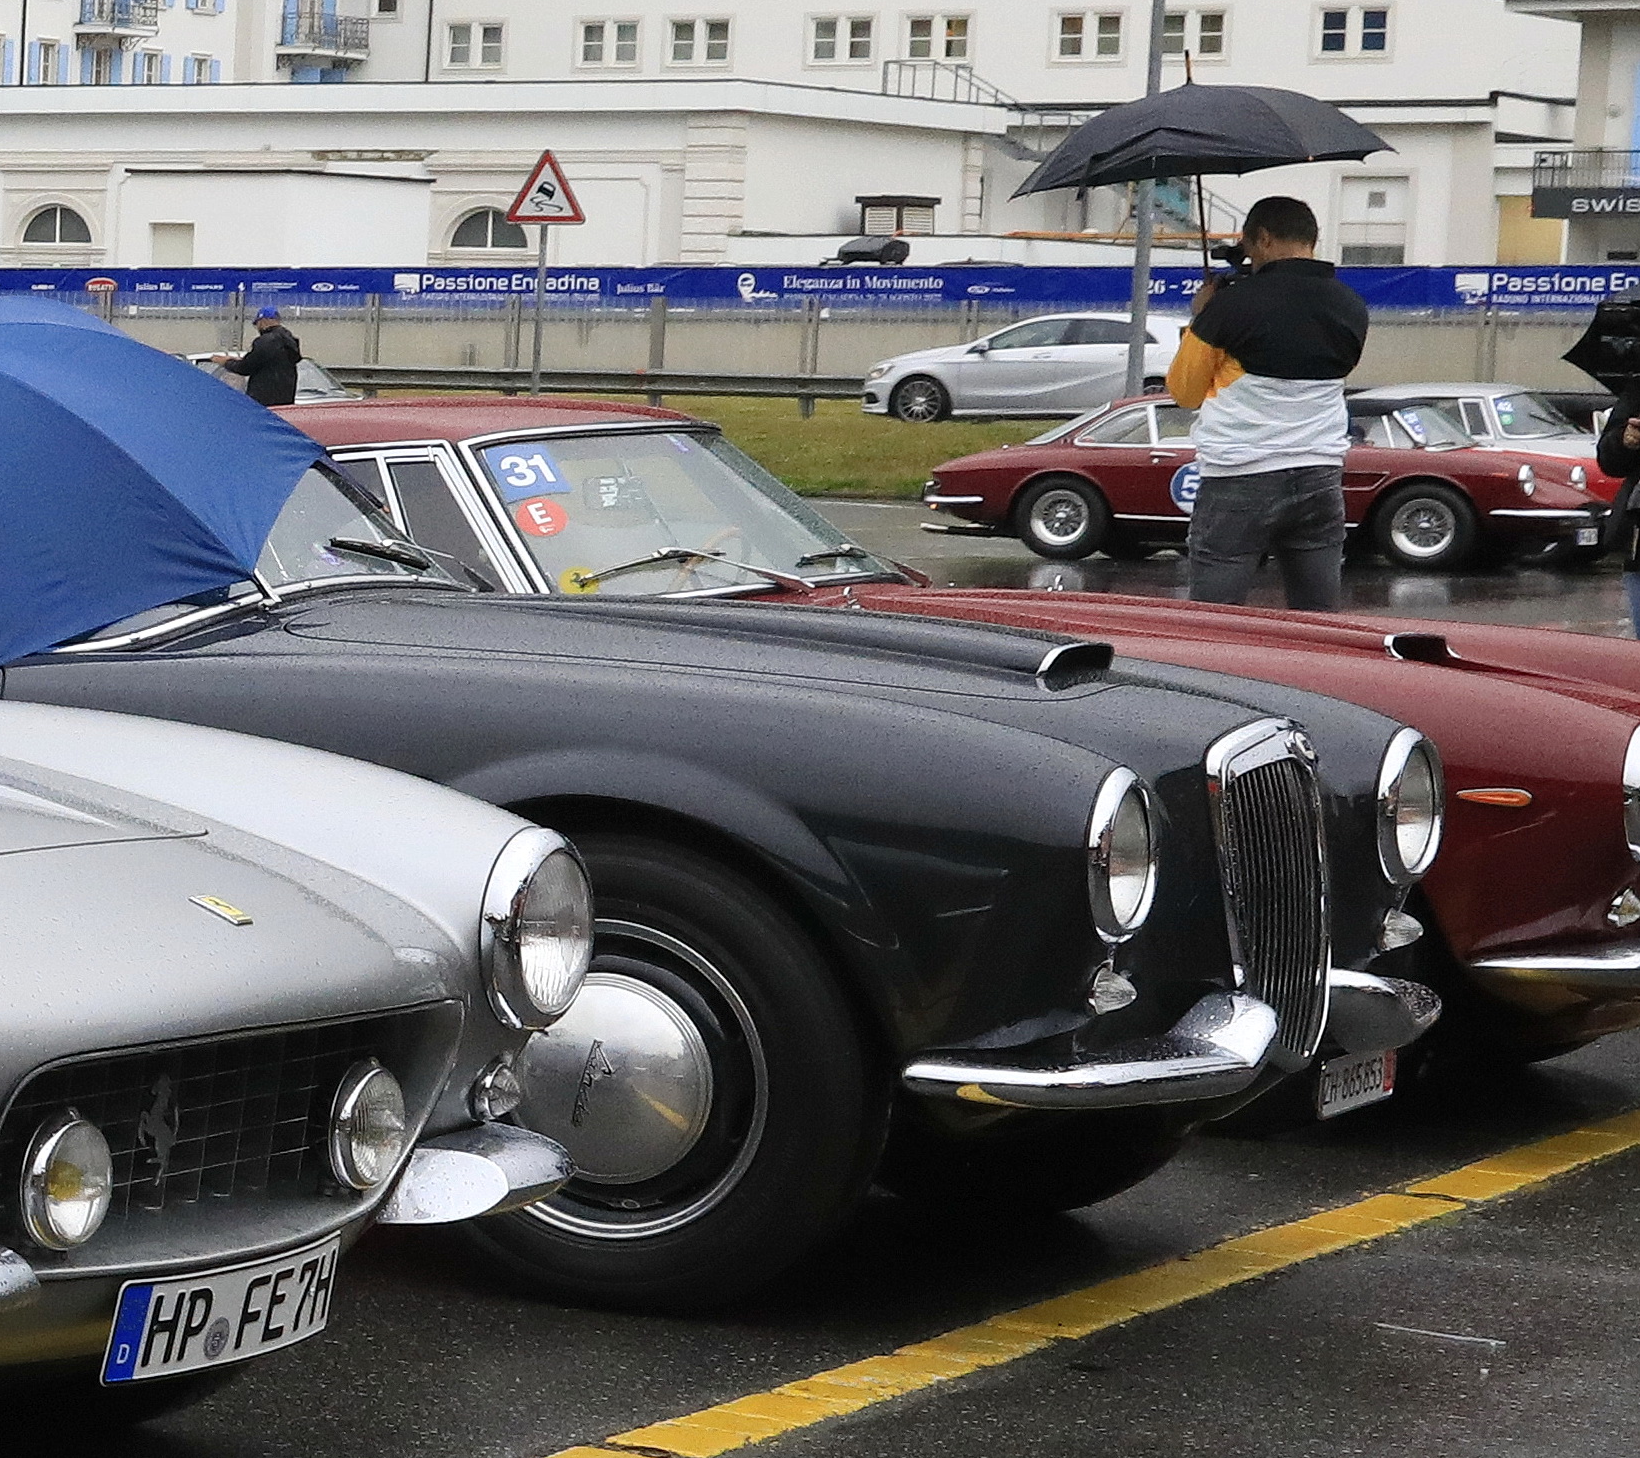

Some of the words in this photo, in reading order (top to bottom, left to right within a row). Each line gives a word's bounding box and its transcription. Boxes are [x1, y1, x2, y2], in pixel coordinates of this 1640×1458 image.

[422, 274, 508, 291] Passione
[783, 276, 843, 291] Eleganza
[846, 275, 861, 289] in
[865, 275, 944, 289] Movimento
[1492, 273, 1606, 292] Passione
[500, 454, 557, 487] 31
[526, 502, 553, 525] E
[116, 1344, 130, 1365] D
[140, 1287, 214, 1368] HP
